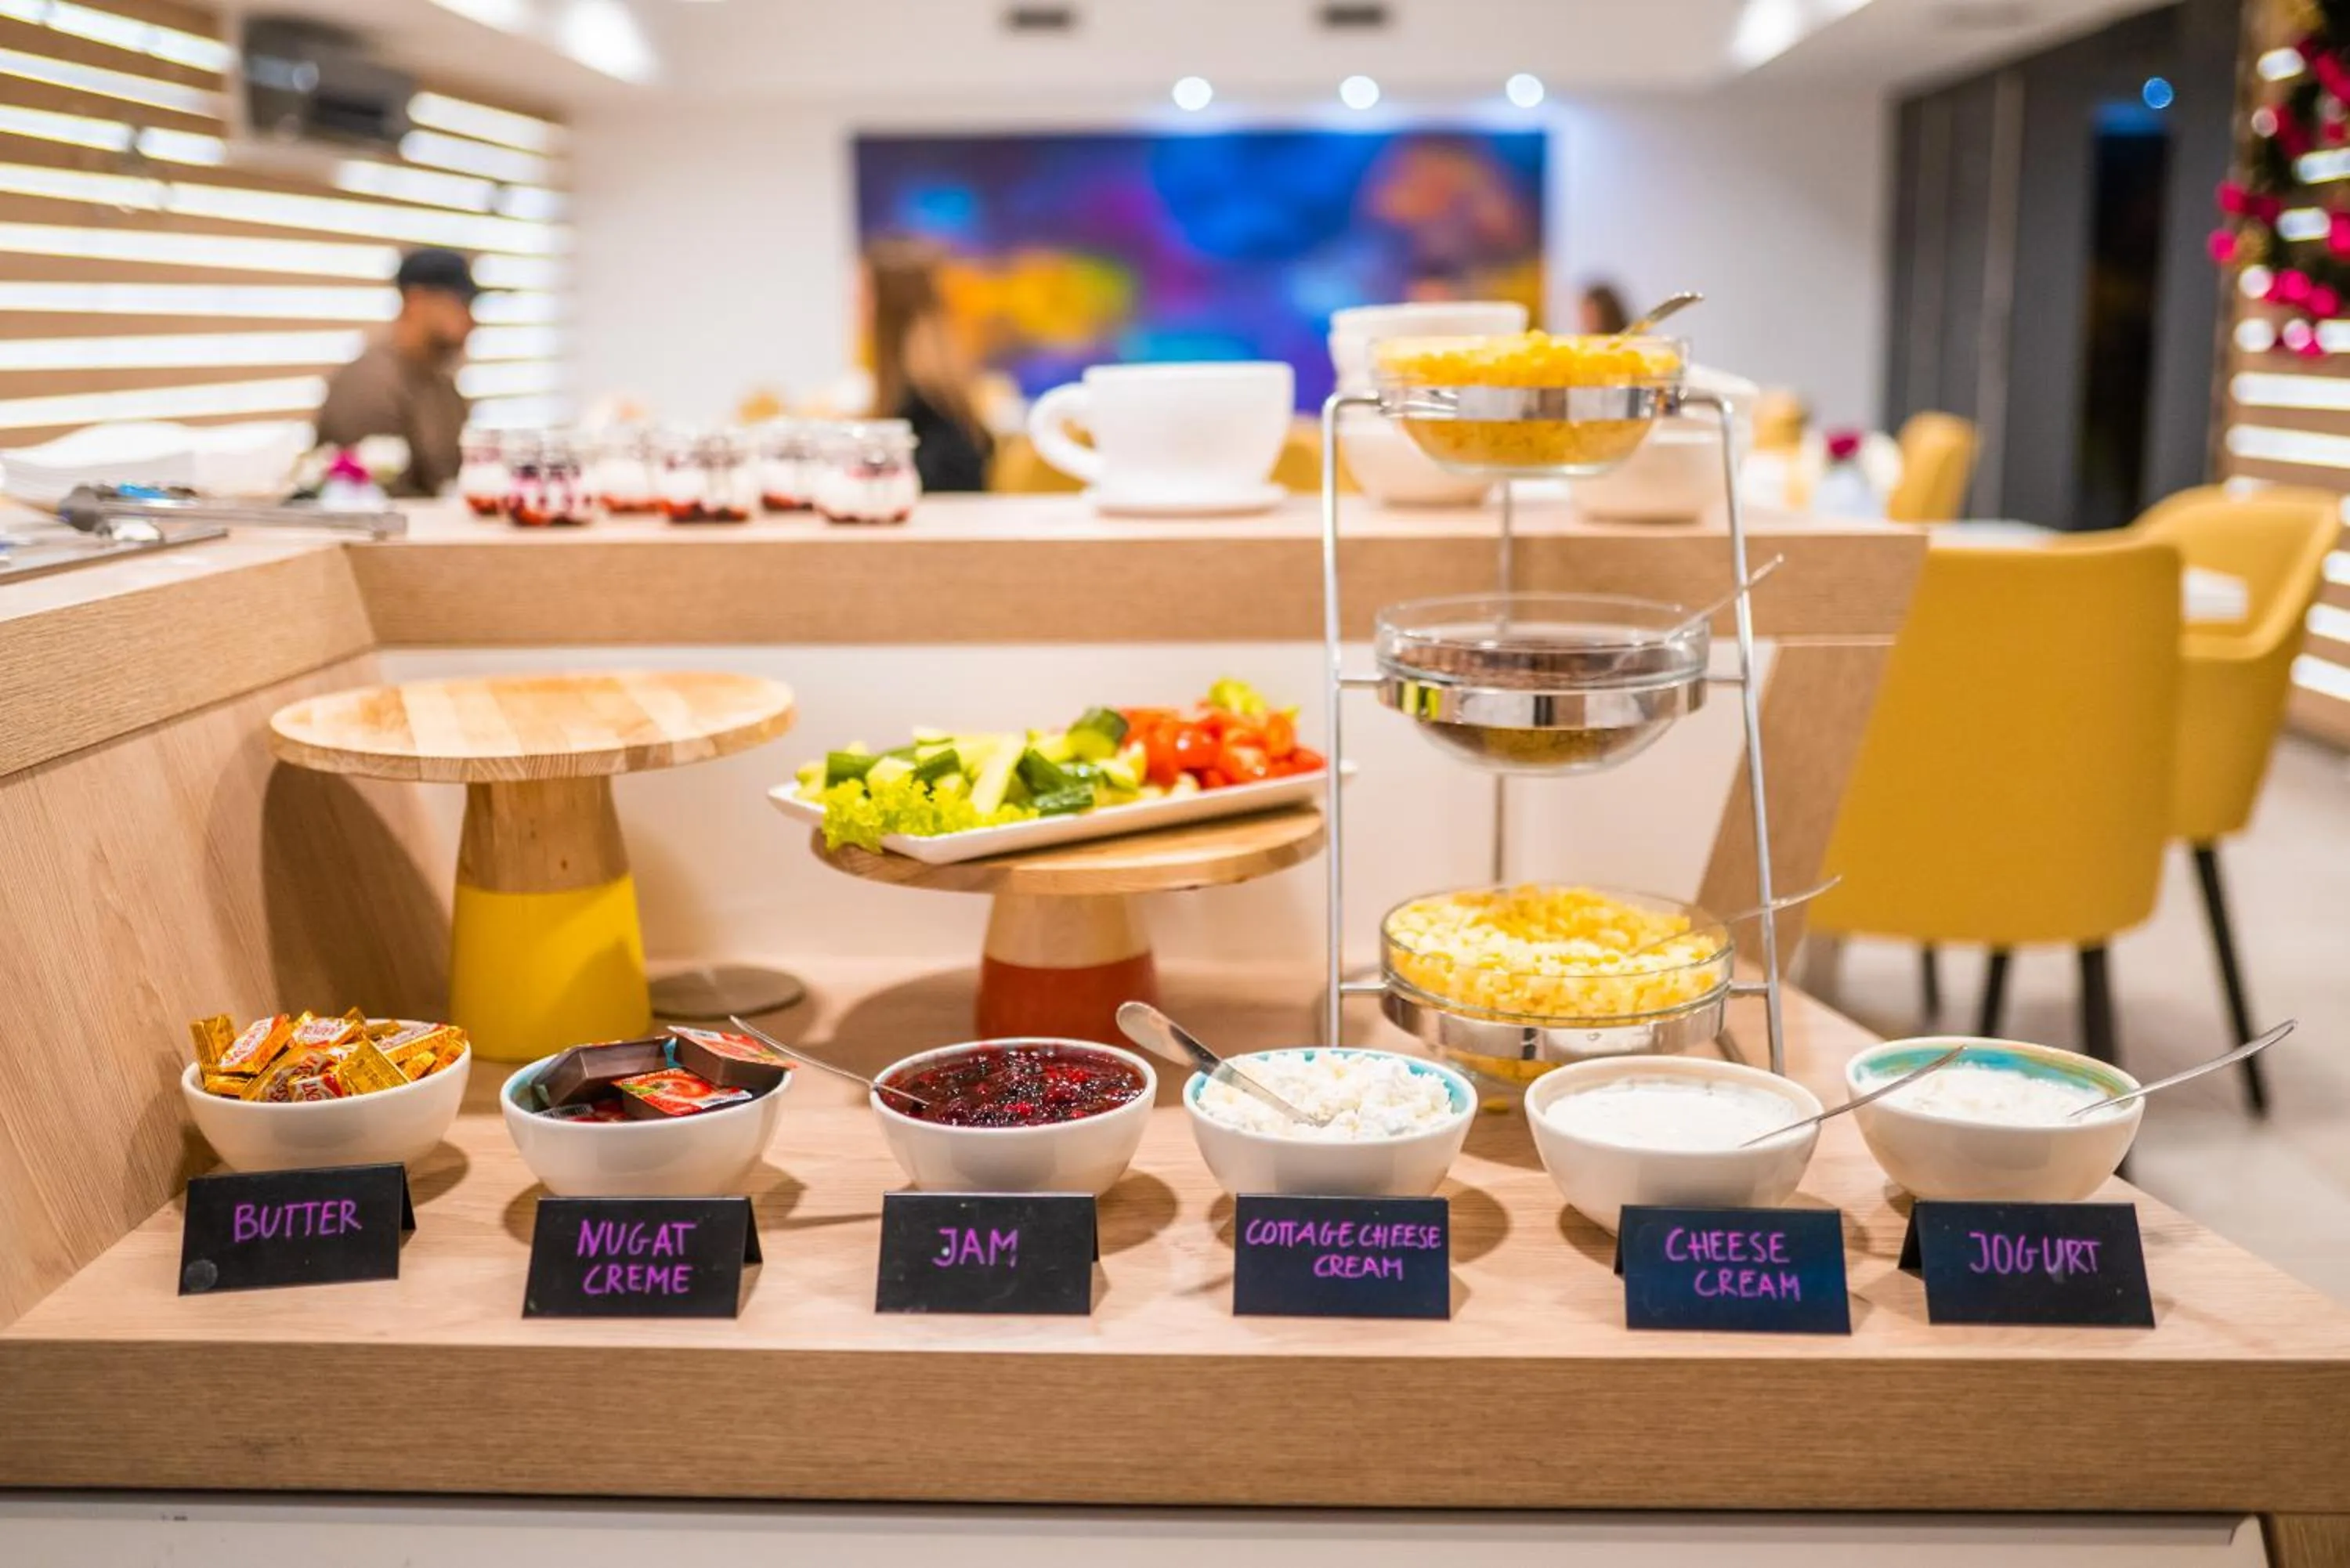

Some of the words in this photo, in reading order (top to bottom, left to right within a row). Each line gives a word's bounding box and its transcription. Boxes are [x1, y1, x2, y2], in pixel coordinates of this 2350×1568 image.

[233, 1199, 362, 1242] BUTTER
[1246, 1219, 1354, 1248] COTTAGE
[1358, 1223, 1441, 1249] CHEESE
[577, 1219, 696, 1258] NUGAT
[932, 1227, 1018, 1268] JAM
[1665, 1228, 1790, 1263] CHEESE
[1969, 1231, 2102, 1275] JOGURT
[583, 1263, 692, 1295] CREME
[1313, 1254, 1403, 1281] CREAM
[1694, 1267, 1801, 1302] CREAM
